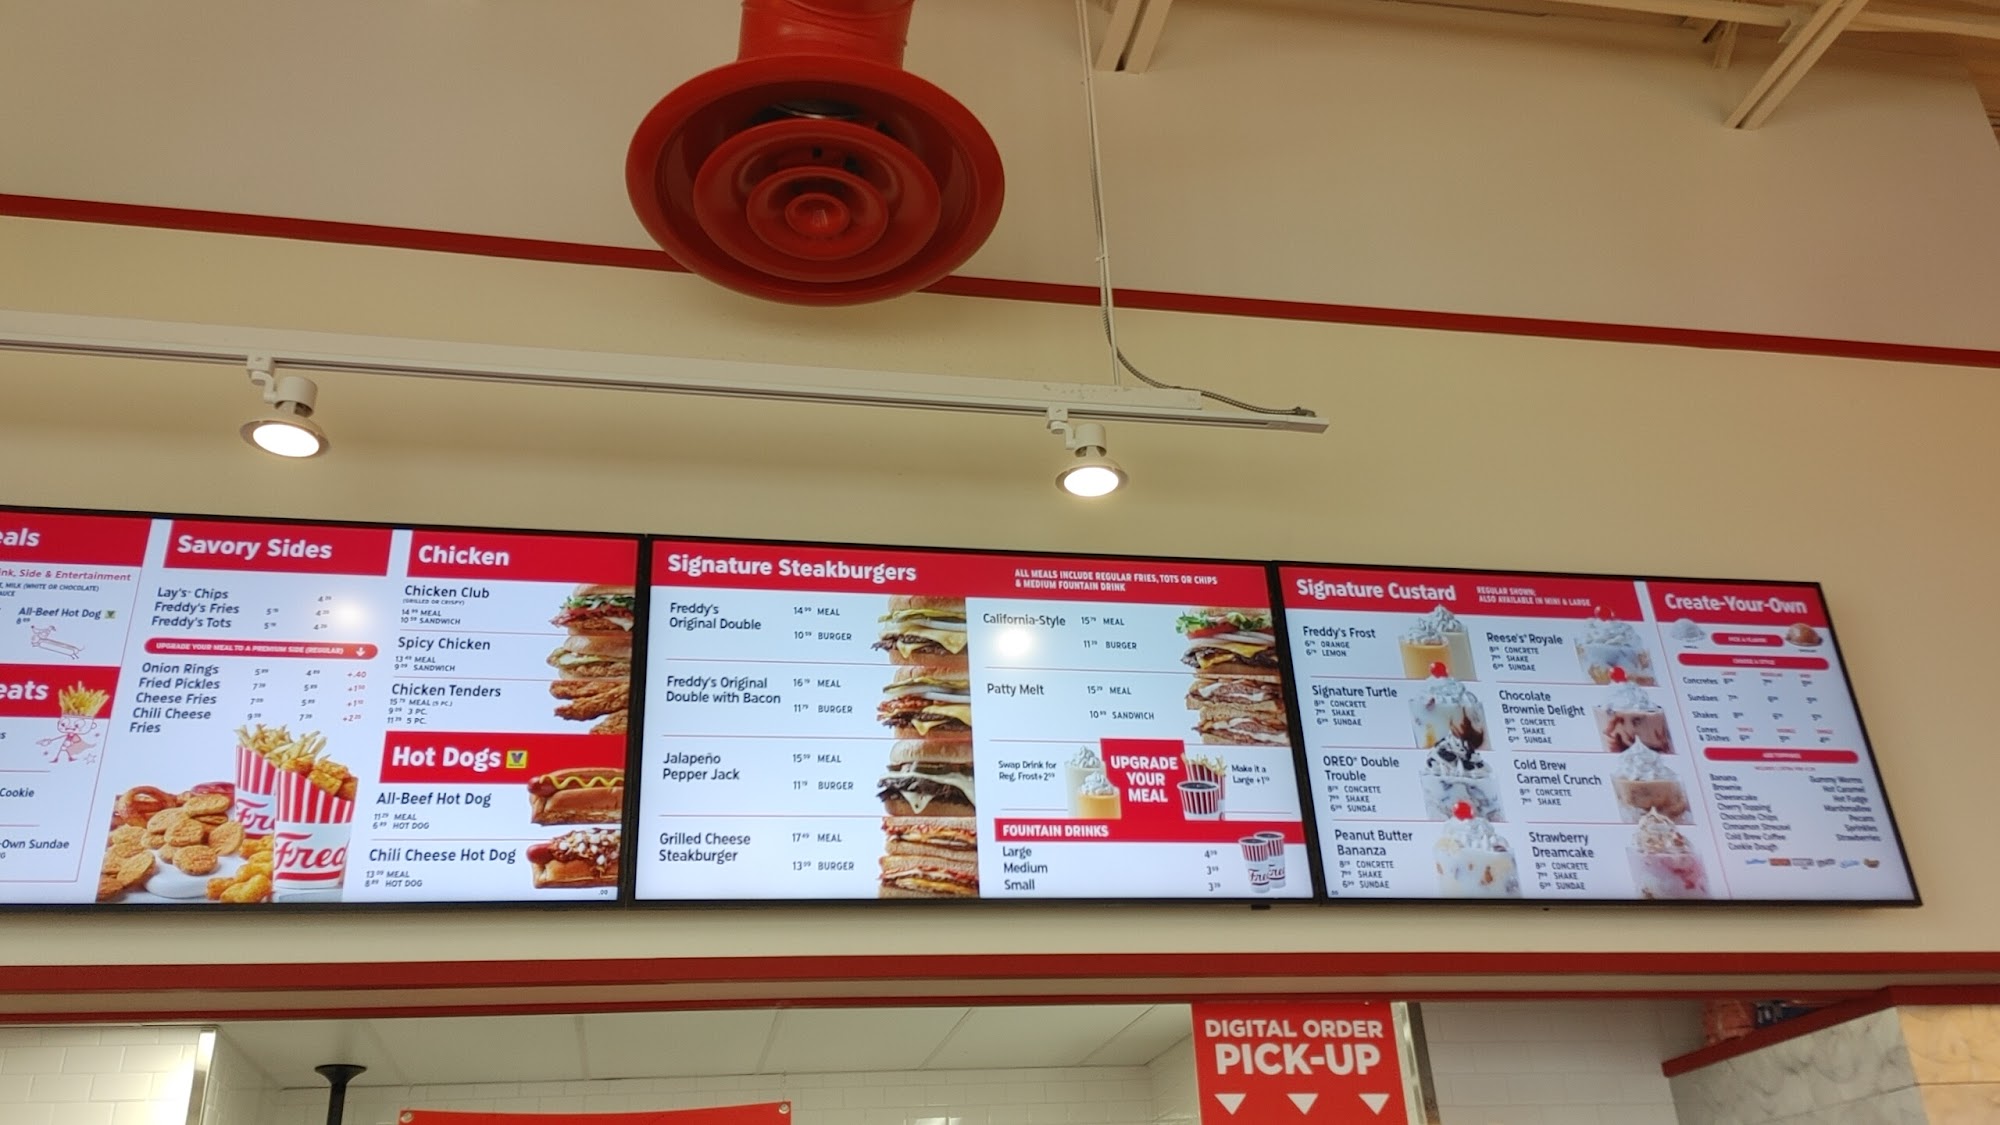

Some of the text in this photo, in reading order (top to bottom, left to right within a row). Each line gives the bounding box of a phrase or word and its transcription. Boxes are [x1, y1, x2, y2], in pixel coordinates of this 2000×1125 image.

[177, 535, 333, 560] Savory Sides
[419, 545, 509, 566] Chicken
[668, 554, 916, 583] Signature Steakburgers
[20, 569, 41, 577] Side
[56, 571, 131, 581] Entertainment
[1015, 569, 1217, 585] ALL MEALS INCLUDE REGULAR FRIES, TOTS OR CHIPS
[405, 585, 489, 598] Chicken Club
[1023, 580, 1056, 589] MEDIUM
[1058, 581, 1099, 590] FOUNTAIN
[1101, 583, 1126, 591] DRINK
[1296, 579, 1456, 601] Signature Custard
[157, 587, 229, 600] Lay's Chips
[154, 602, 239, 614] Freddy's Fries
[670, 603, 719, 616] Freddy's
[1664, 593, 1807, 614] Create-Your-Own
[18, 608, 101, 619] All-Beef Hot Dog
[818, 608, 840, 616] MEAL
[152, 616, 231, 628] Freddy's Tots
[670, 618, 761, 630] Original Double
[983, 613, 1066, 627] California-Style
[818, 632, 852, 641] BURGER
[1303, 626, 1375, 639] Freddy's Frost
[398, 637, 490, 651] Spicy Chicken
[1487, 632, 1563, 646] Reese's Royale
[1106, 642, 1137, 650] BURGER
[142, 663, 219, 676] Onion Rings
[139, 678, 220, 689] Fried Pickles
[667, 676, 768, 691] Freddy's Original
[817, 679, 841, 688] MEAL
[392, 683, 501, 697] Chicken Tenders
[987, 684, 1044, 697] Patty Melt
[1110, 687, 1131, 695] MEAL
[1312, 685, 1397, 698] Signature Turtle
[1499, 690, 1551, 701] Chocolate
[136, 693, 216, 704] Cheese Fries
[666, 692, 781, 704] Double with Bacon
[1330, 700, 1366, 708] CONCRETE
[133, 708, 211, 719] Chili Cheese
[818, 705, 853, 713] BURGER
[1502, 704, 1585, 717] Brownie Delight
[1693, 711, 1718, 719] Shakes
[1112, 712, 1154, 720] SANDWICH
[1333, 718, 1362, 726] SUNDAE
[130, 722, 161, 733] Fries
[392, 747, 501, 772] Hot Dogs
[663, 752, 721, 766] Jalapeño
[817, 755, 841, 763] MEAL
[999, 760, 1056, 770] Swap Drink for
[1111, 756, 1178, 770] UPGRADE
[1323, 756, 1399, 767] OREO Double
[1514, 760, 1566, 770] Cold Brew
[1232, 765, 1248, 773] Make
[663, 769, 740, 782] Pepper Jack
[1127, 772, 1165, 786] YOUR
[1232, 776, 1254, 784] Large
[1325, 771, 1366, 781] Trouble
[1517, 774, 1601, 785] Caramel Crunch
[818, 782, 853, 790] BURGER
[0, 788, 34, 797] Cookie
[1129, 788, 1168, 802] MEAL
[376, 792, 492, 808] All-Beef Hot Dog
[1003, 824, 1109, 837] FOUNTAIN DRINKS
[1335, 830, 1412, 841] Peanut Butter
[660, 833, 751, 845] Grilled Cheese
[817, 834, 842, 842] MEAL
[1529, 832, 1588, 844] Strawberry
[1002, 847, 1032, 858] Large
[1337, 845, 1386, 855] Bananza
[1532, 847, 1594, 858] Dreamcake
[369, 849, 516, 864] Chili Cheese Hot Dog
[659, 850, 738, 864] Steakburger
[818, 862, 854, 870] BURGER
[1004, 863, 1048, 874] Medium
[1004, 879, 1034, 890] Small
[1205, 1019, 1383, 1038] DIGITAL ORDER
[1215, 1043, 1380, 1075] PICK-UP
